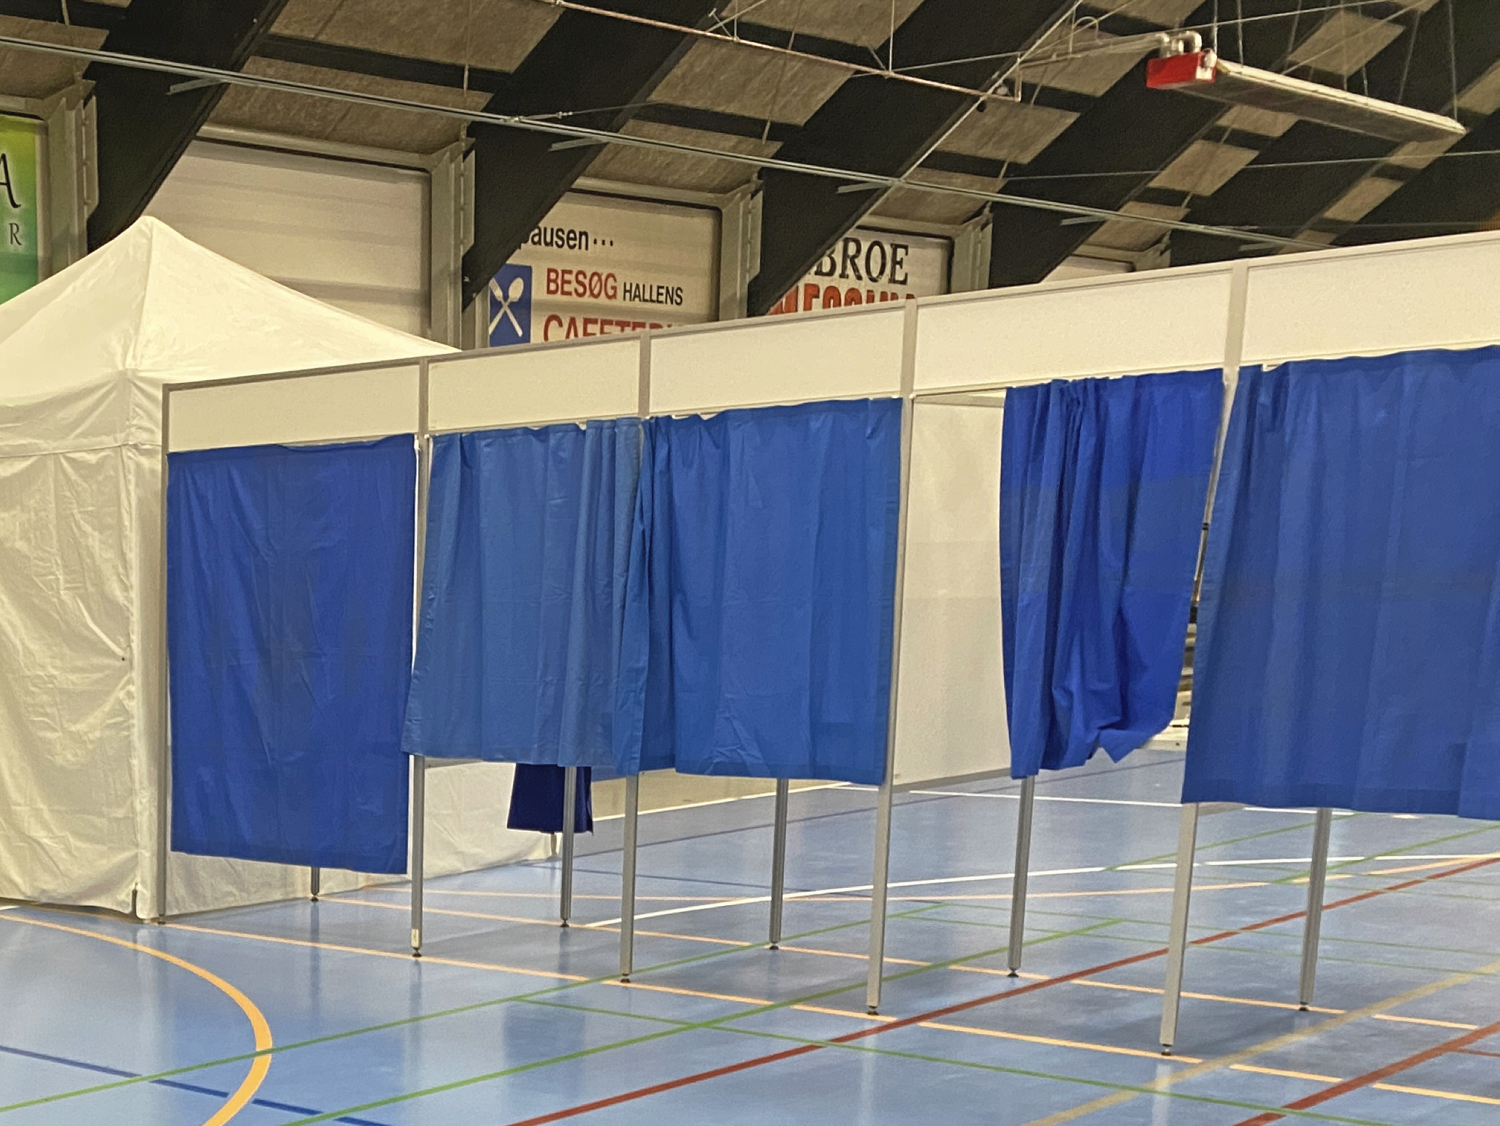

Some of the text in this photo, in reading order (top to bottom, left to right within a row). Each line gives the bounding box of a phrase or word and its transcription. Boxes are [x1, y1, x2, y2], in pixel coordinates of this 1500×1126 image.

[807, 237, 910, 285] BROE
[546, 268, 683, 306] BESØG HALLENS
